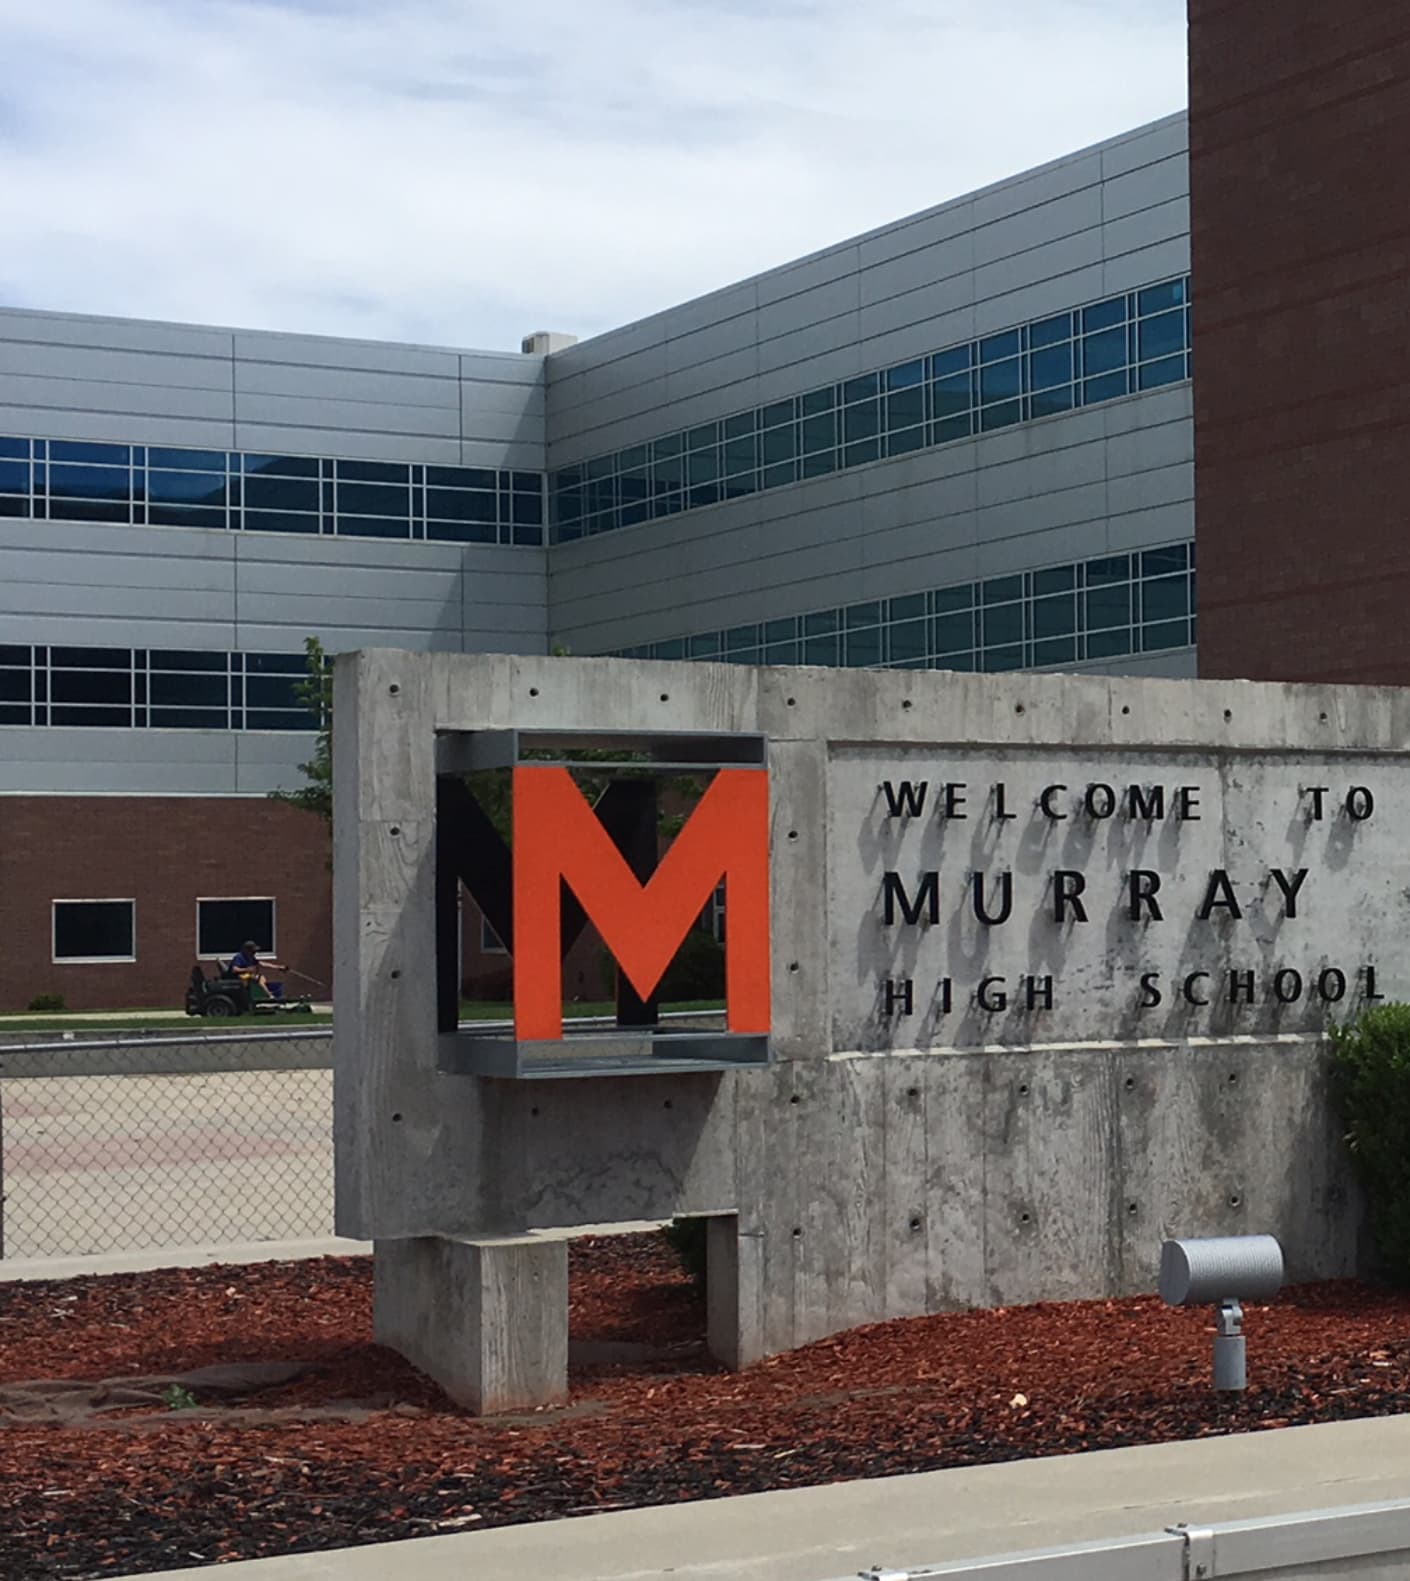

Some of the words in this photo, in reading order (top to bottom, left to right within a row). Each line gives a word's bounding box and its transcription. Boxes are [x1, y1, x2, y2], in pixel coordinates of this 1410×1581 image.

[883, 781, 1201, 821] WELCOME
[1307, 786, 1375, 821] TO
[512, 766, 771, 1041] M
[883, 869, 1309, 926] MURRAY
[885, 975, 1054, 1015] HIGH
[1140, 966, 1385, 1007] SCHOOL
